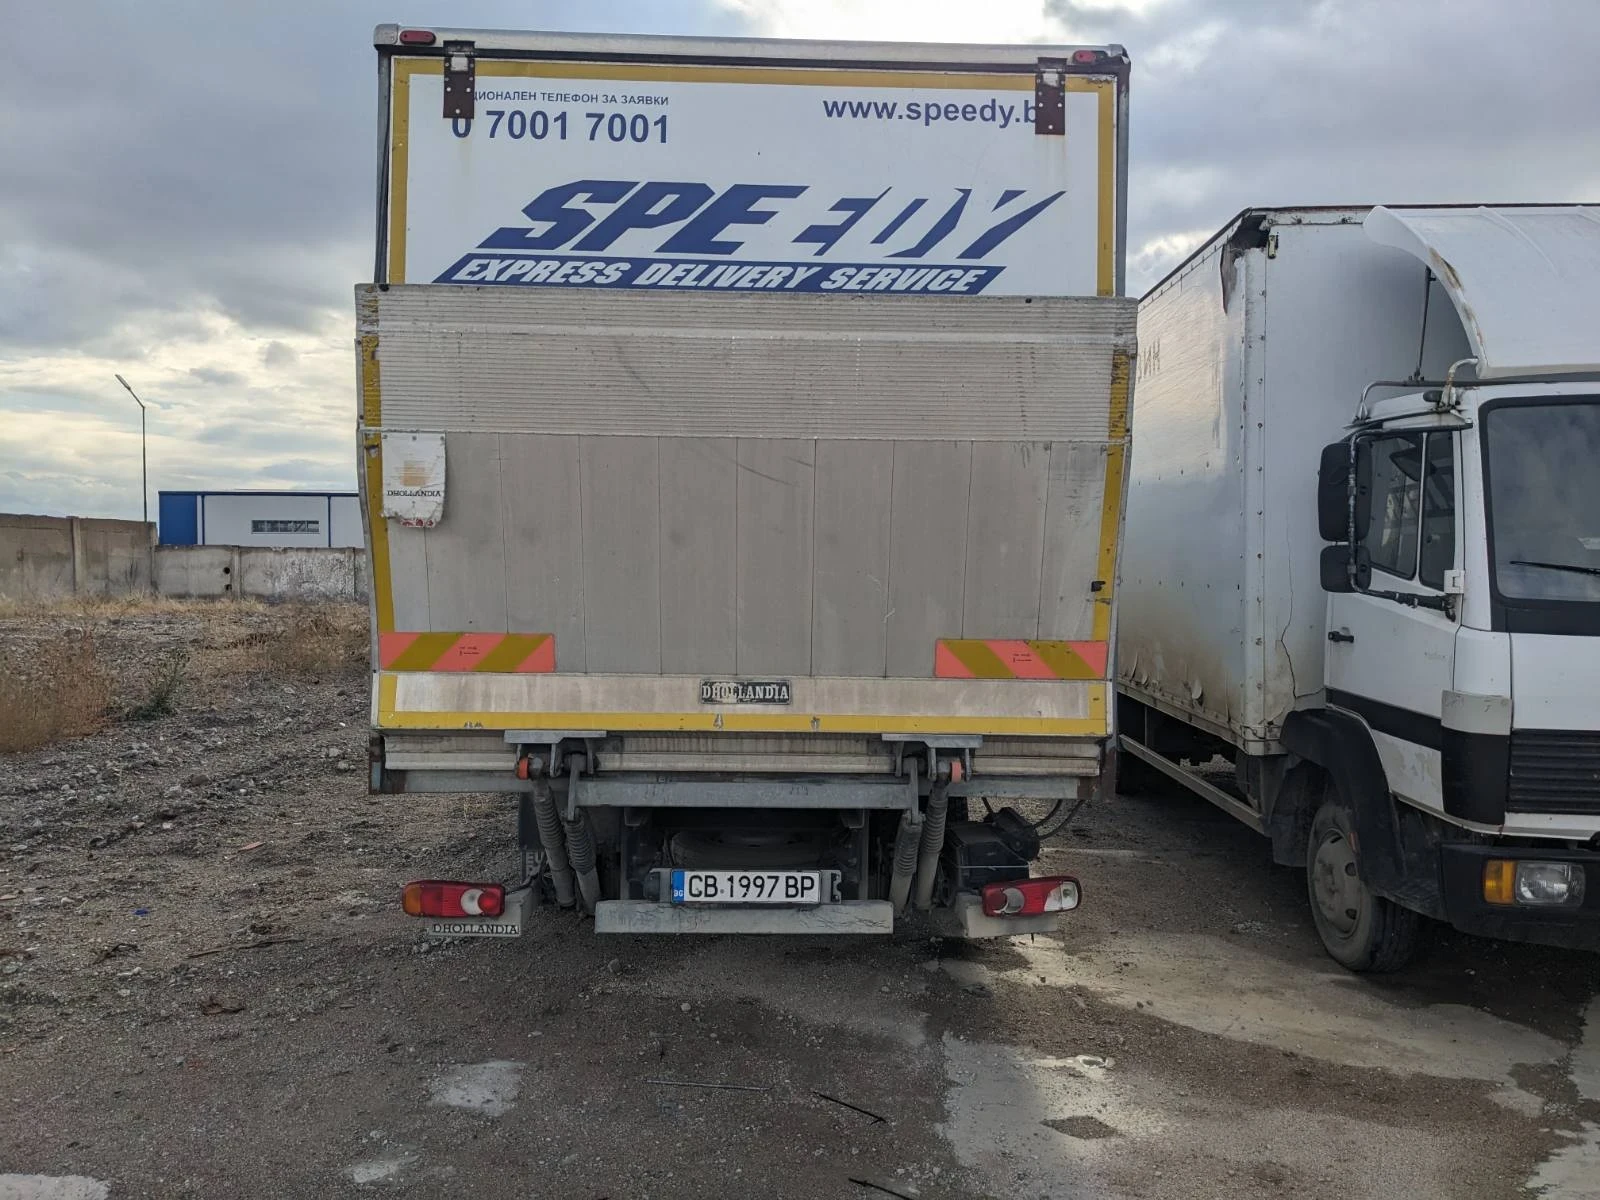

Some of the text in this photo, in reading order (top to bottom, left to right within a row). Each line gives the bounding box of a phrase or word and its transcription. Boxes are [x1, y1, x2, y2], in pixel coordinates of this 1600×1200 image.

[540, 92, 599, 104] ТЕЛЕФОН
[602, 94, 618, 104] ЗА
[621, 95, 669, 105] ЗАЯВКИ
[822, 98, 1036, 129] www.speedy.b
[452, 109, 667, 143] 0 7001 7001
[475, 179, 1067, 260] SPEEDY
[450, 258, 988, 291] EXPRESS DELIVERY SERVICE
[386, 489, 441, 497] DHOLLANDIA
[702, 684, 789, 700] DHOLLANDIA
[673, 889, 684, 897] BG
[688, 875, 815, 898] CB 1997 BP
[432, 923, 519, 934] DHOLLANDIA
